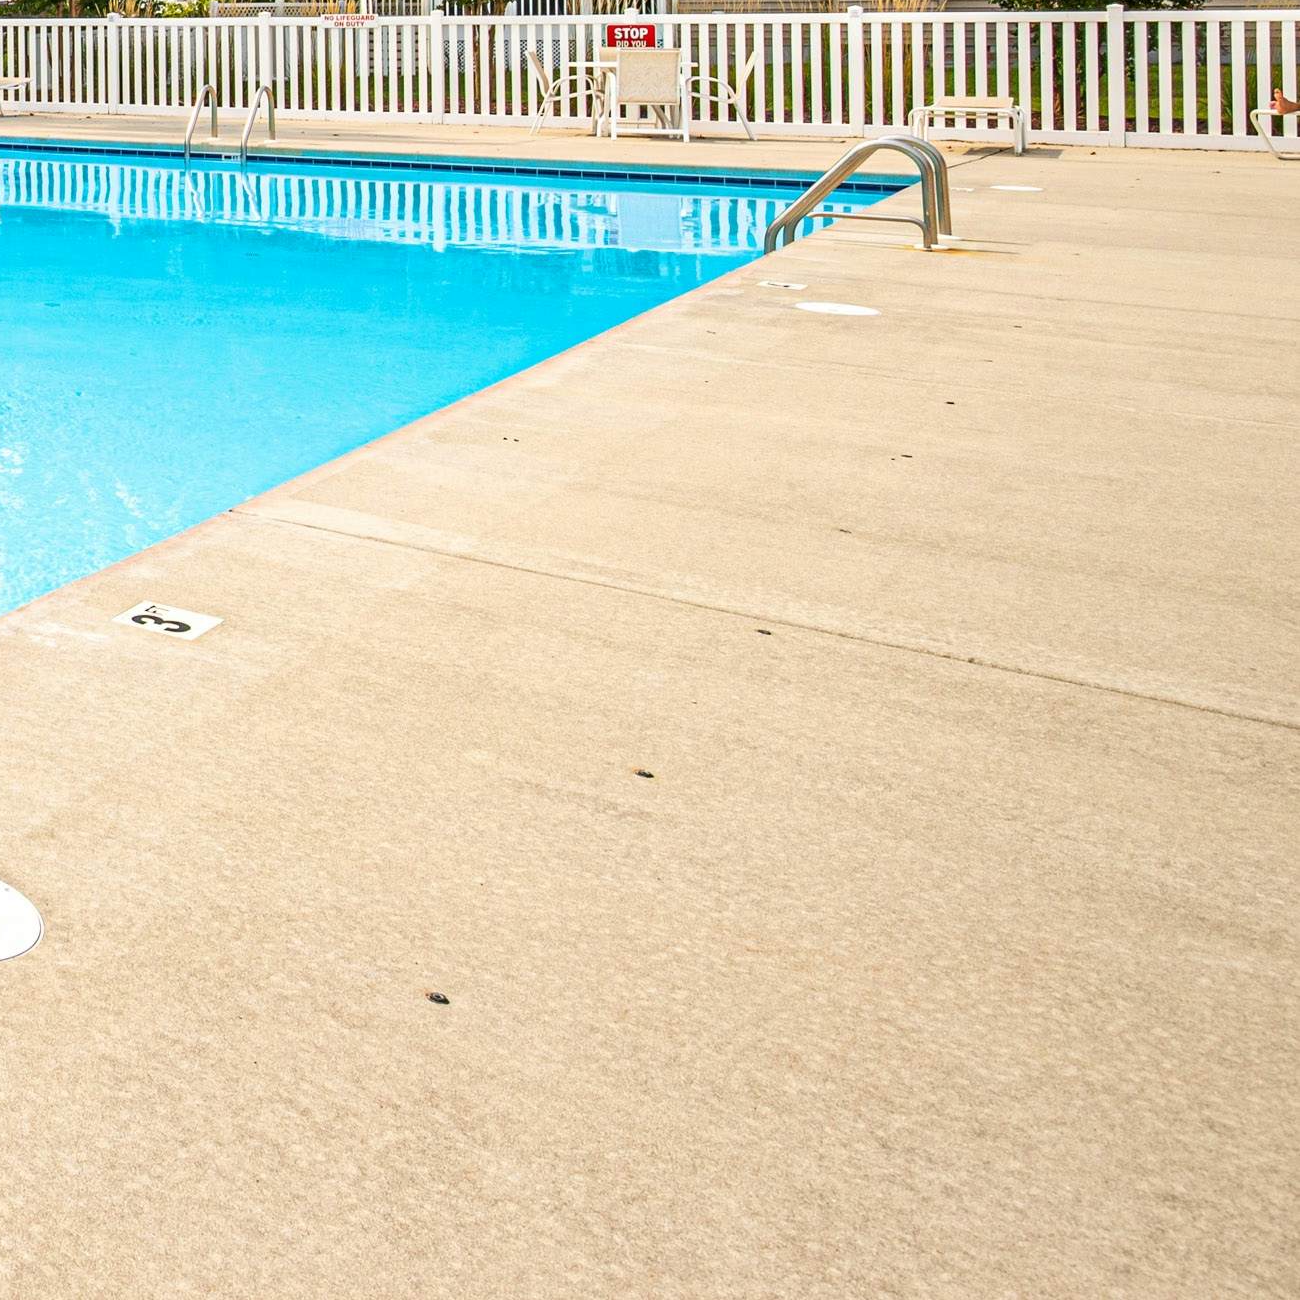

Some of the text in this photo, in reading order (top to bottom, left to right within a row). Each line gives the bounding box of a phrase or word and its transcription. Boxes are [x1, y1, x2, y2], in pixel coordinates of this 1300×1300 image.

[614, 27, 649, 39] STOP
[616, 40, 647, 48] DID YOU
[131, 614, 191, 633] 3
